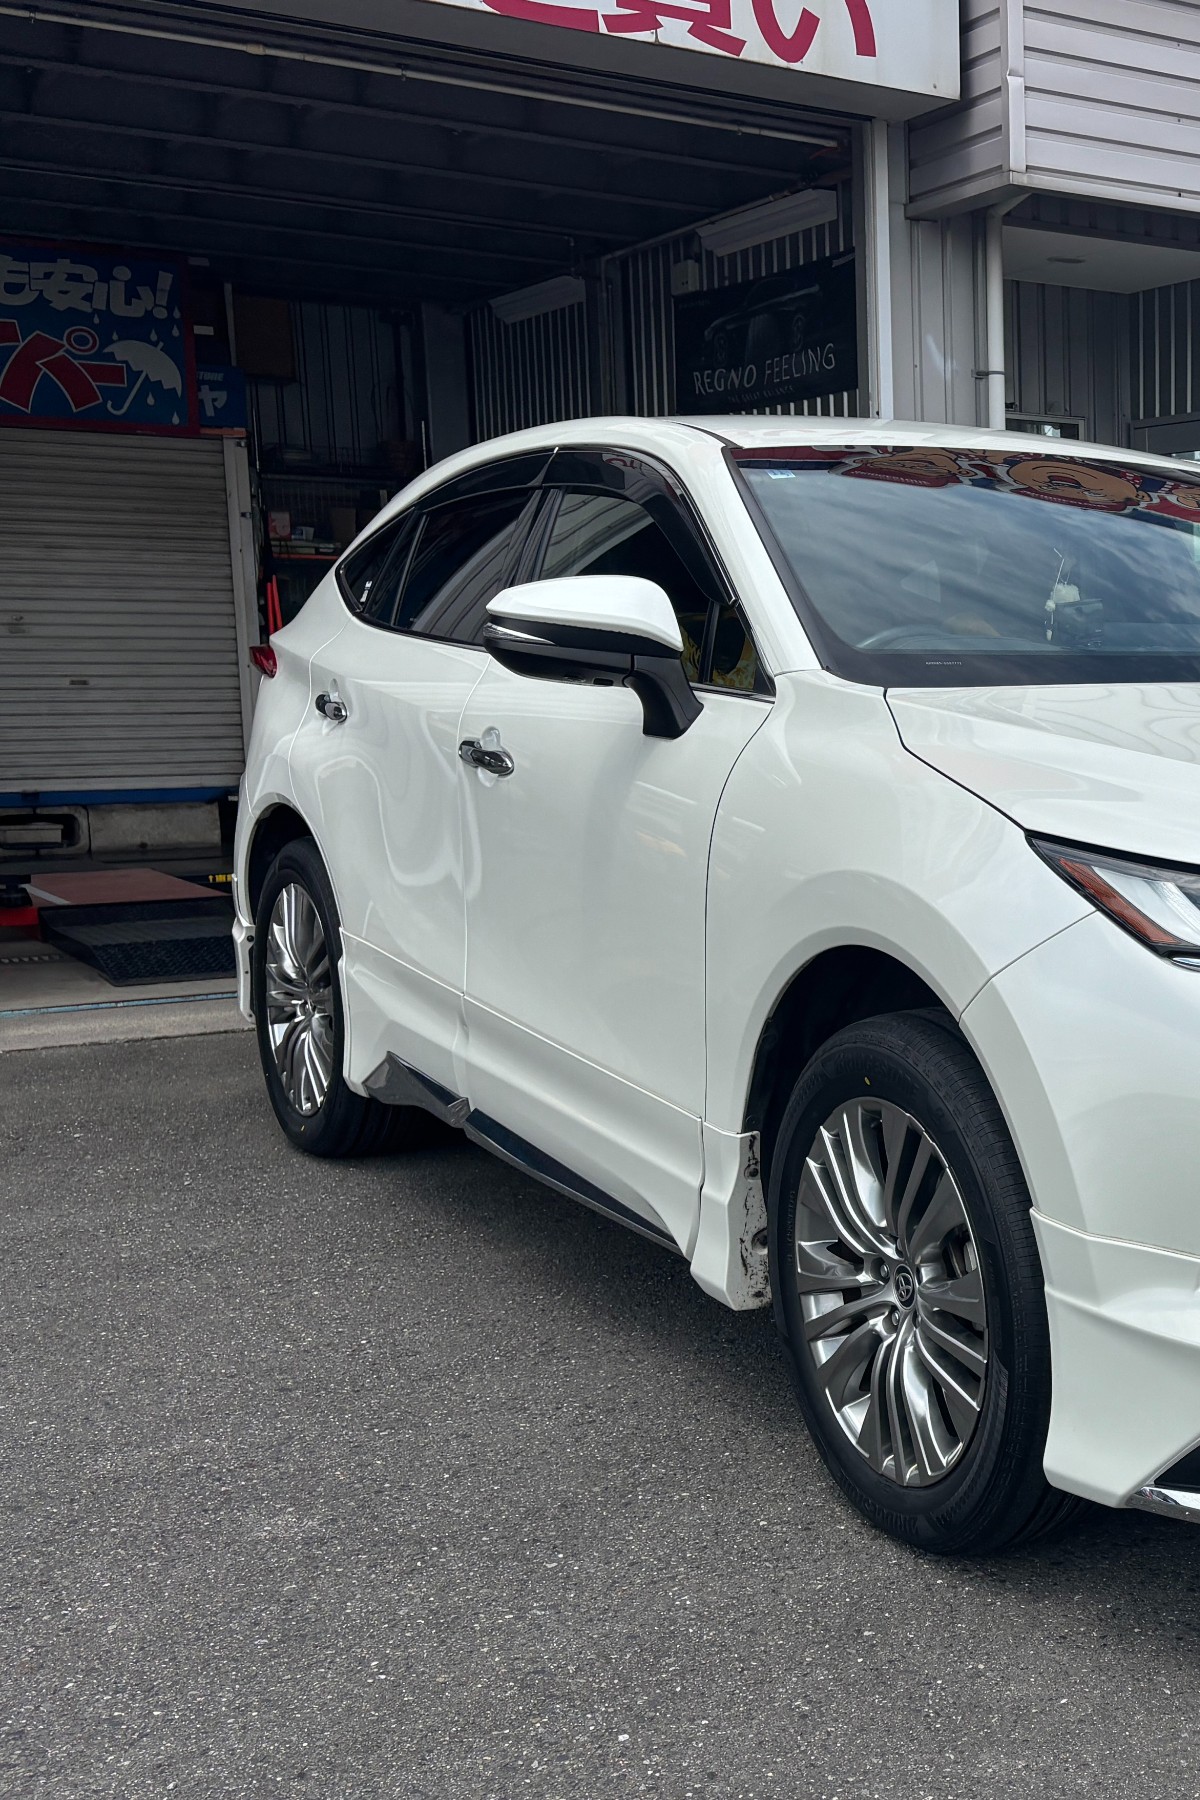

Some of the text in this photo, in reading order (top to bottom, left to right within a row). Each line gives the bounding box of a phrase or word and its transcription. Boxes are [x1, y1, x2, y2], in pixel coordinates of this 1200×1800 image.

[0, 318, 128, 413] パー
[692, 343, 836, 396] REGNO FEELING
